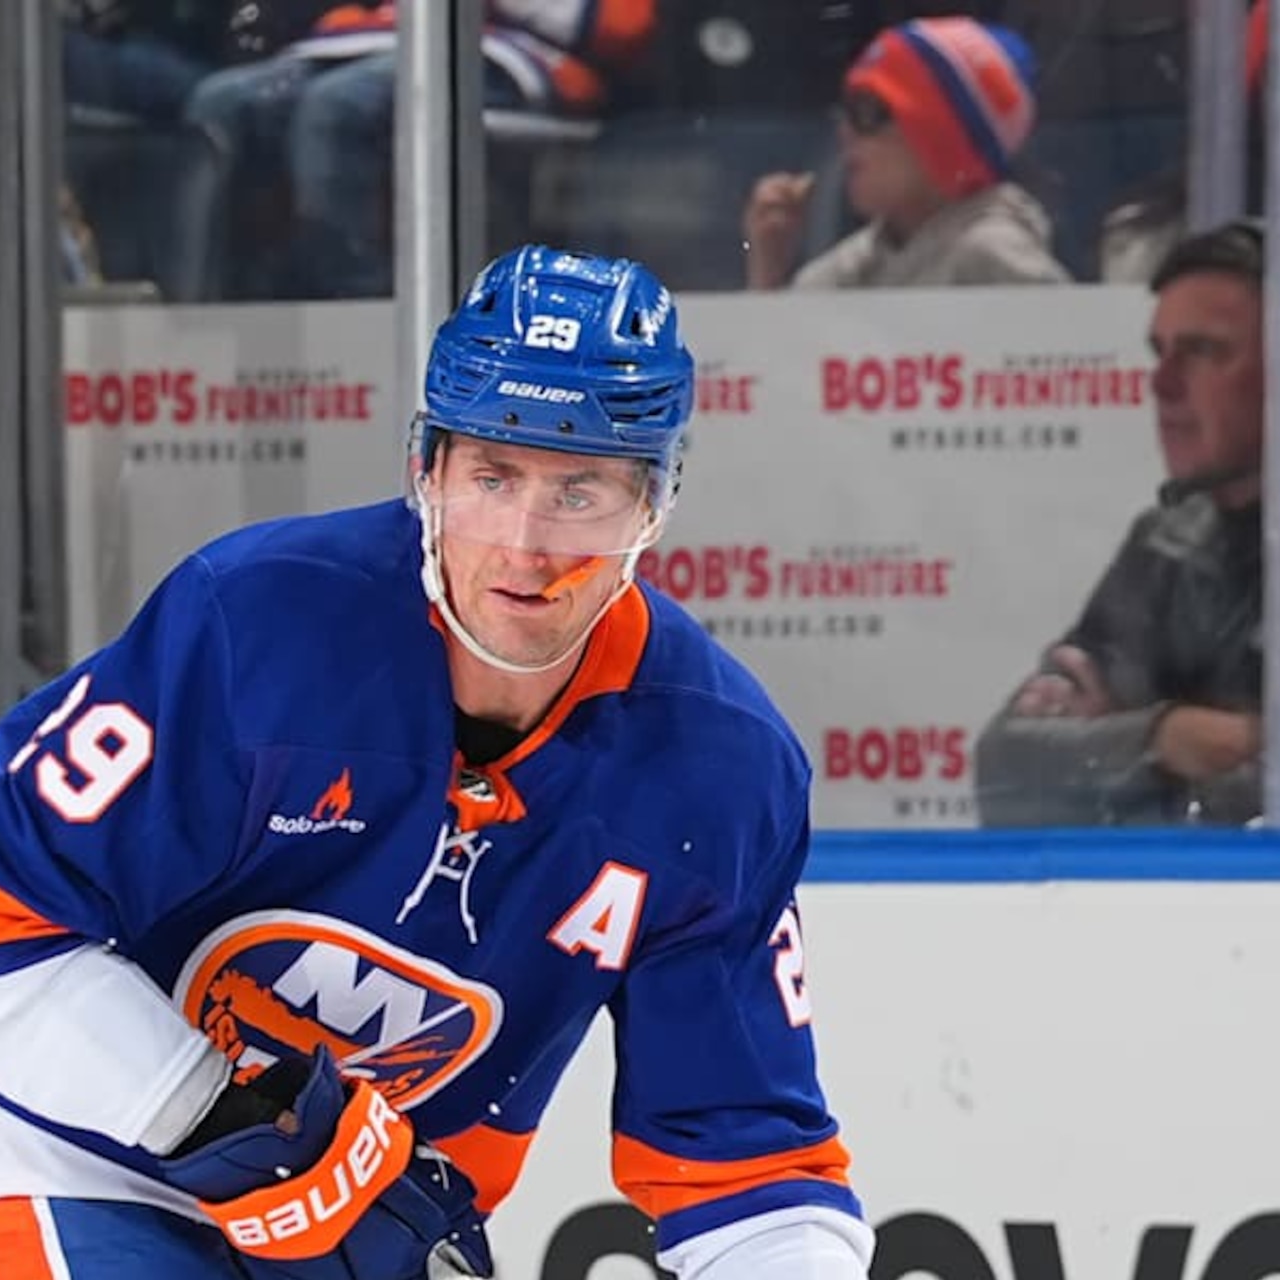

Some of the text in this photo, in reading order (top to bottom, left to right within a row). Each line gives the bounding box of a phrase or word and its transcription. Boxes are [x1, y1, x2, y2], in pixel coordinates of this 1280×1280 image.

[525, 314, 581, 352] 29
[64, 370, 373, 427] BOB'S FURNITURE
[822, 356, 1146, 411] BOB'S FURNITURE
[780, 556, 949, 598] FURNITURE
[825, 726, 967, 783] BOB'S
[546, 860, 649, 971] A
[226, 1089, 400, 1248] BAUER
